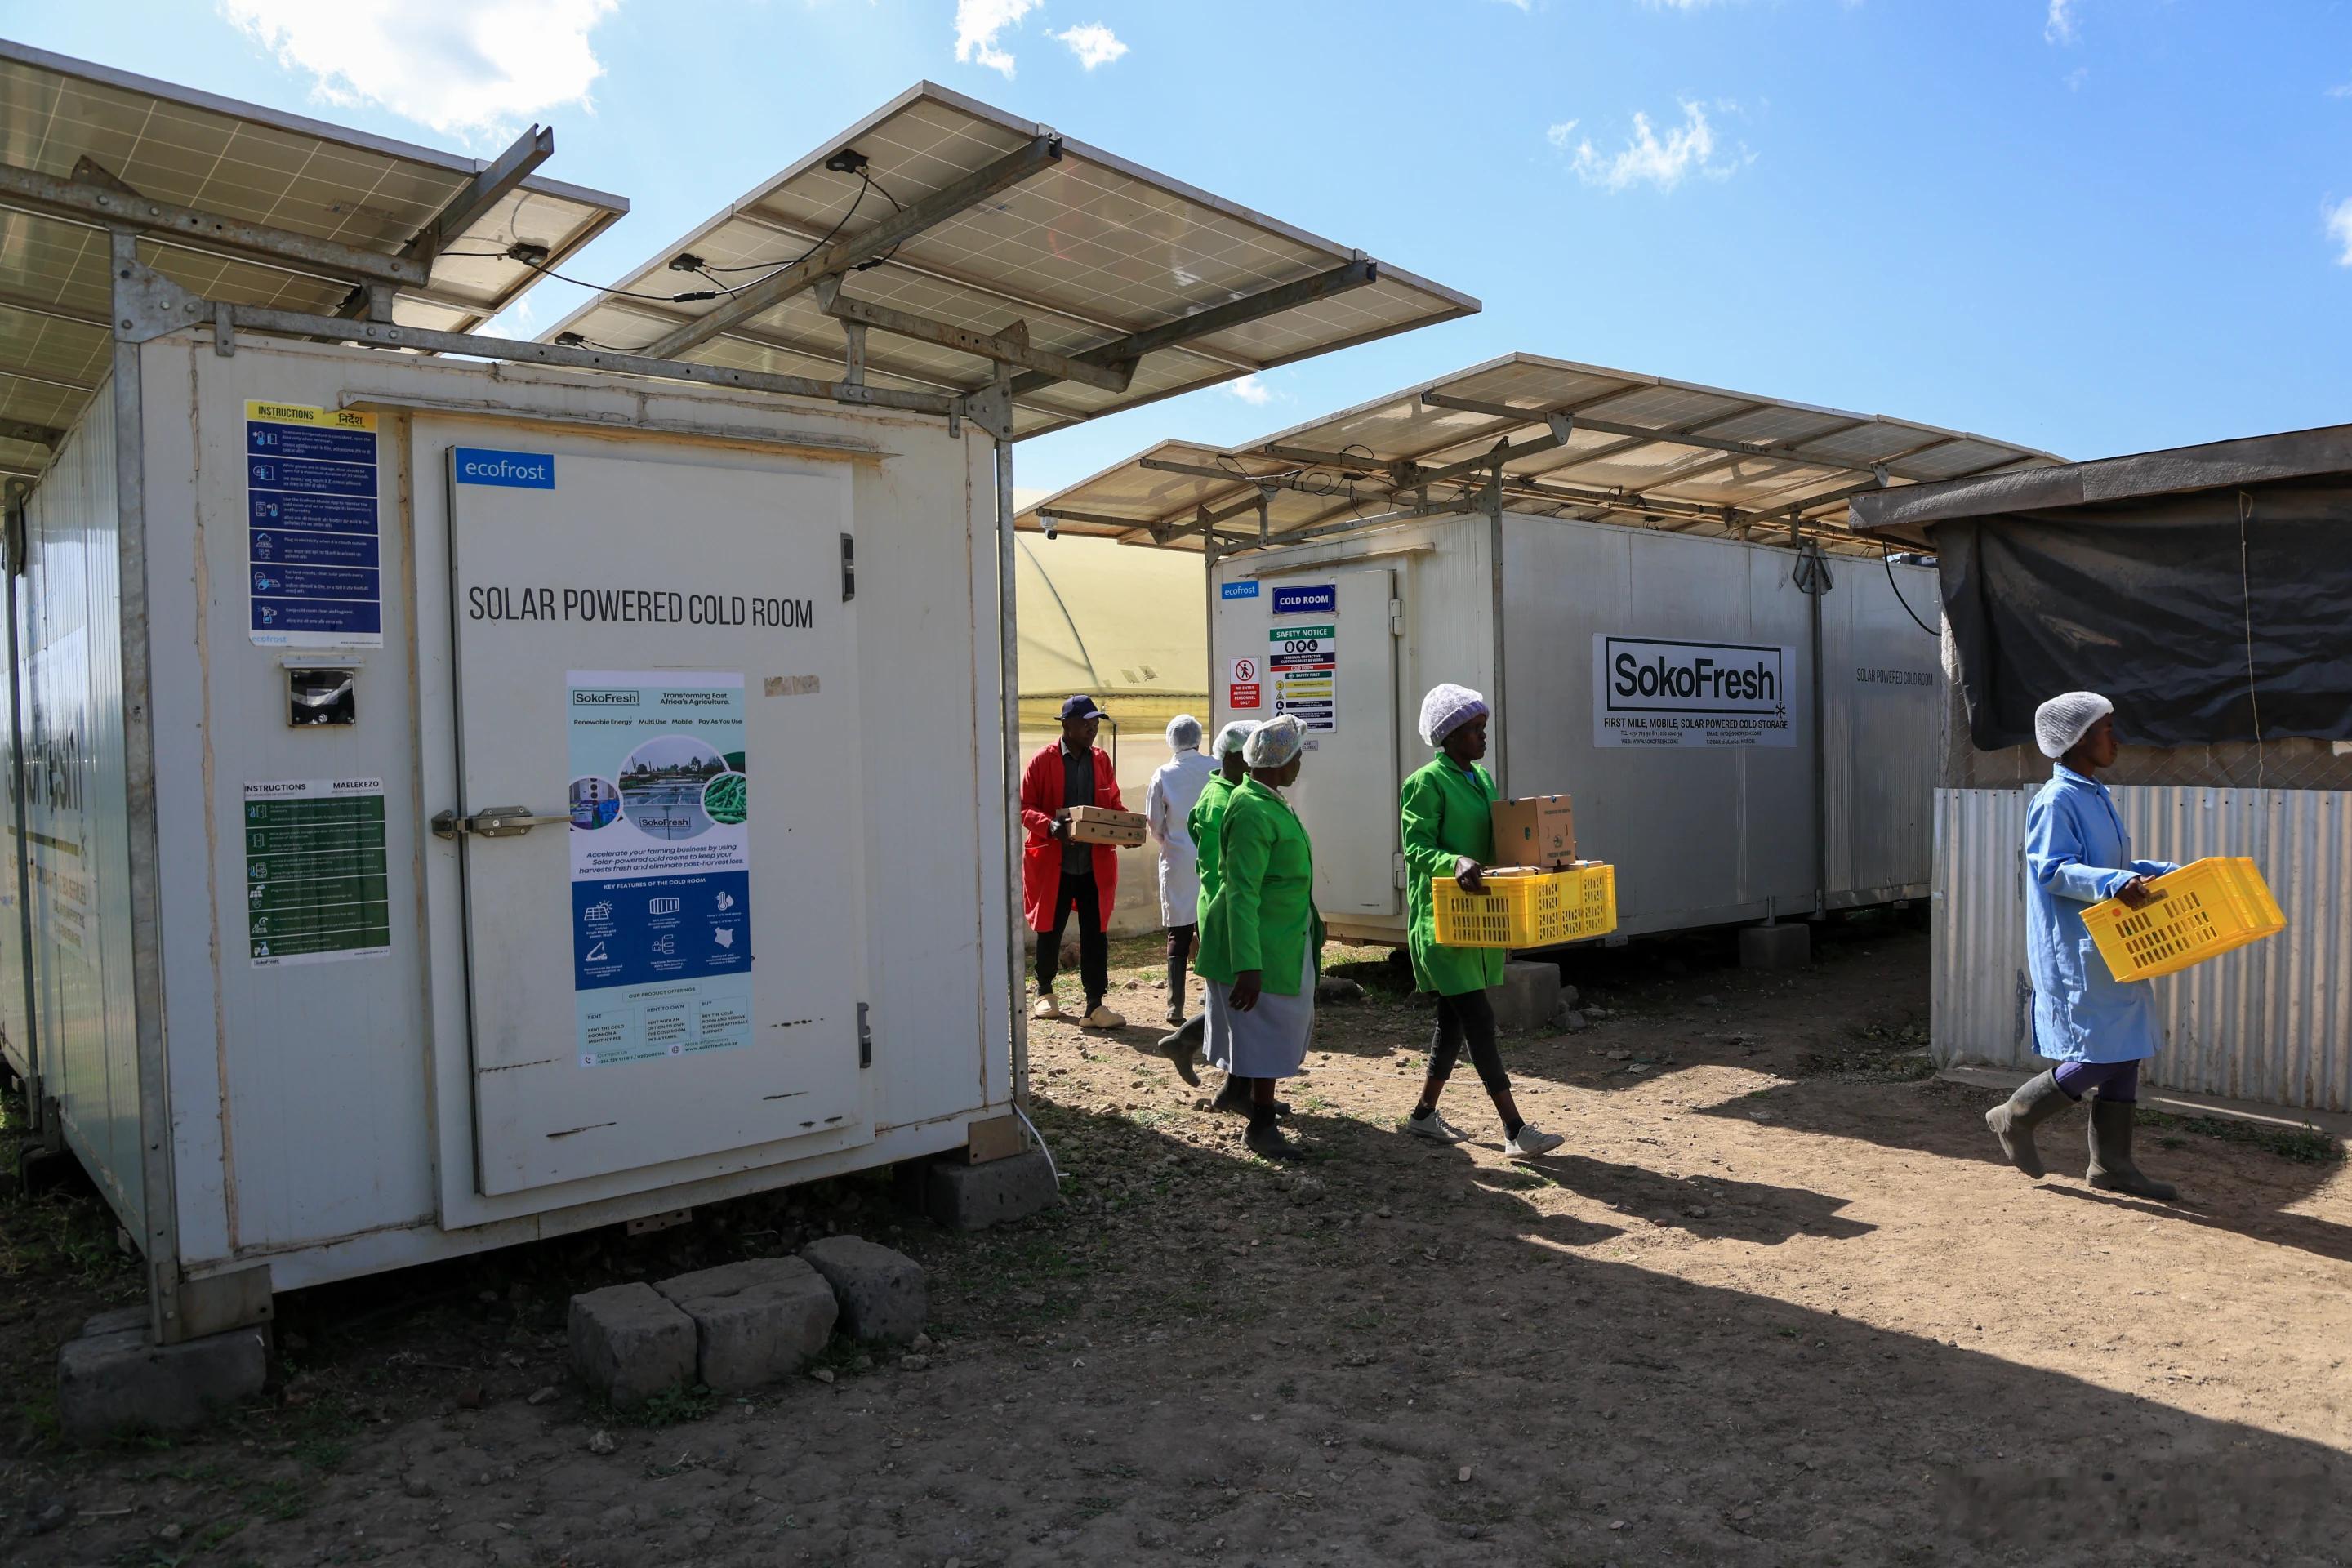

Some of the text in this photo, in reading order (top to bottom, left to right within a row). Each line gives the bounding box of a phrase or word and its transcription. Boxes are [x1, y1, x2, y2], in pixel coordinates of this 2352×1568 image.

[258, 406, 314, 420] INSTRUCTIONS
[339, 413, 363, 425] निर्देश
[466, 461, 546, 480] ecofrost
[1225, 586, 1255, 595] ecofrost
[1280, 595, 1329, 605] COLD ROOM
[469, 586, 813, 629] SOLAR POWERED COLD ROOM
[1276, 628, 1327, 639] SAFETY NOTICE
[1615, 653, 1774, 700] SokoFresh
[1857, 668, 1933, 686] SOLAR POWERED COLD ROOM
[576, 693, 636, 703] SokoFresh
[1604, 718, 1788, 730] FIRST MILE, MOBILE, SOLAR POWERED COLD STORAGE
[245, 784, 306, 792] INSTRUCTIONS
[332, 781, 379, 789] MAELEKEZO
[592, 856, 648, 865] Solar-powered
[684, 860, 728, 868] post-harvest
